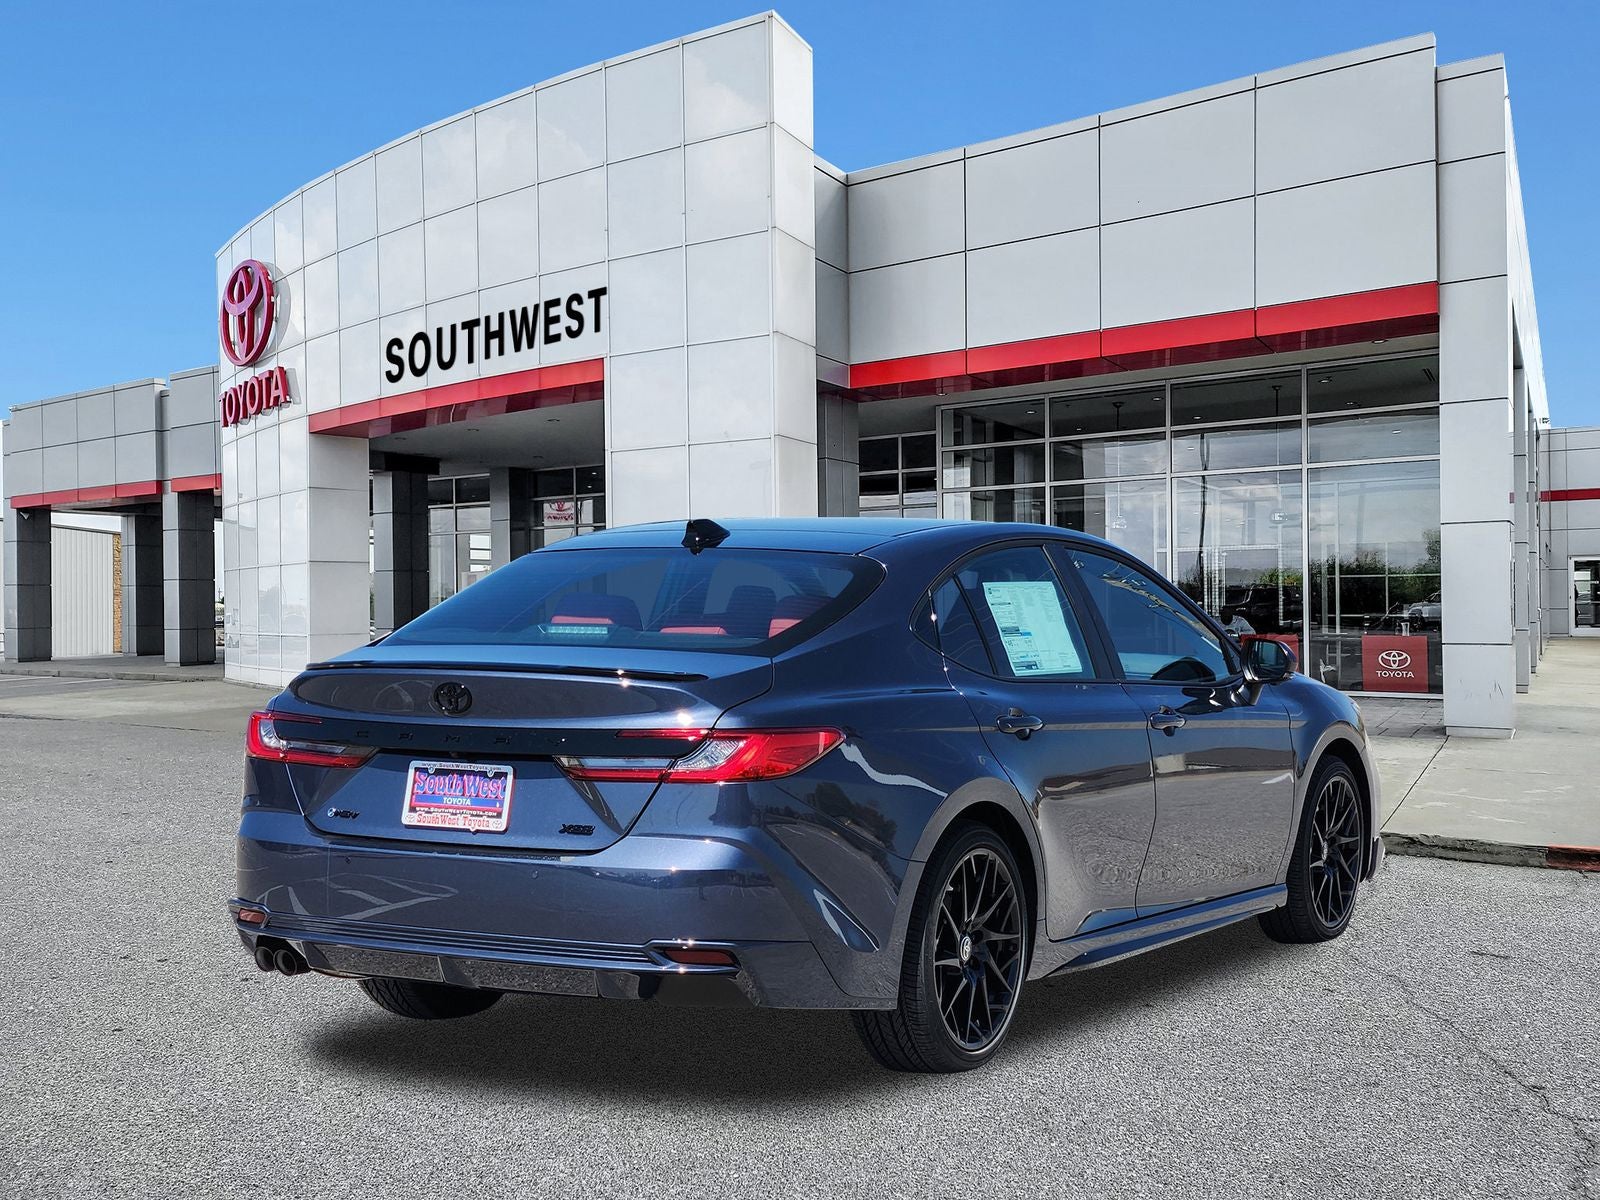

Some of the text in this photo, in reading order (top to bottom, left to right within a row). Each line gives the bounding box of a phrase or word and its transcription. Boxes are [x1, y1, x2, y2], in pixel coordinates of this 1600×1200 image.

[385, 287, 607, 383] SOUTHWEST
[218, 366, 290, 428] TOYOTA
[1376, 670, 1415, 678] TOYOTA
[443, 797, 471, 806] TOYOTA
[463, 816, 490, 829] Toyota
